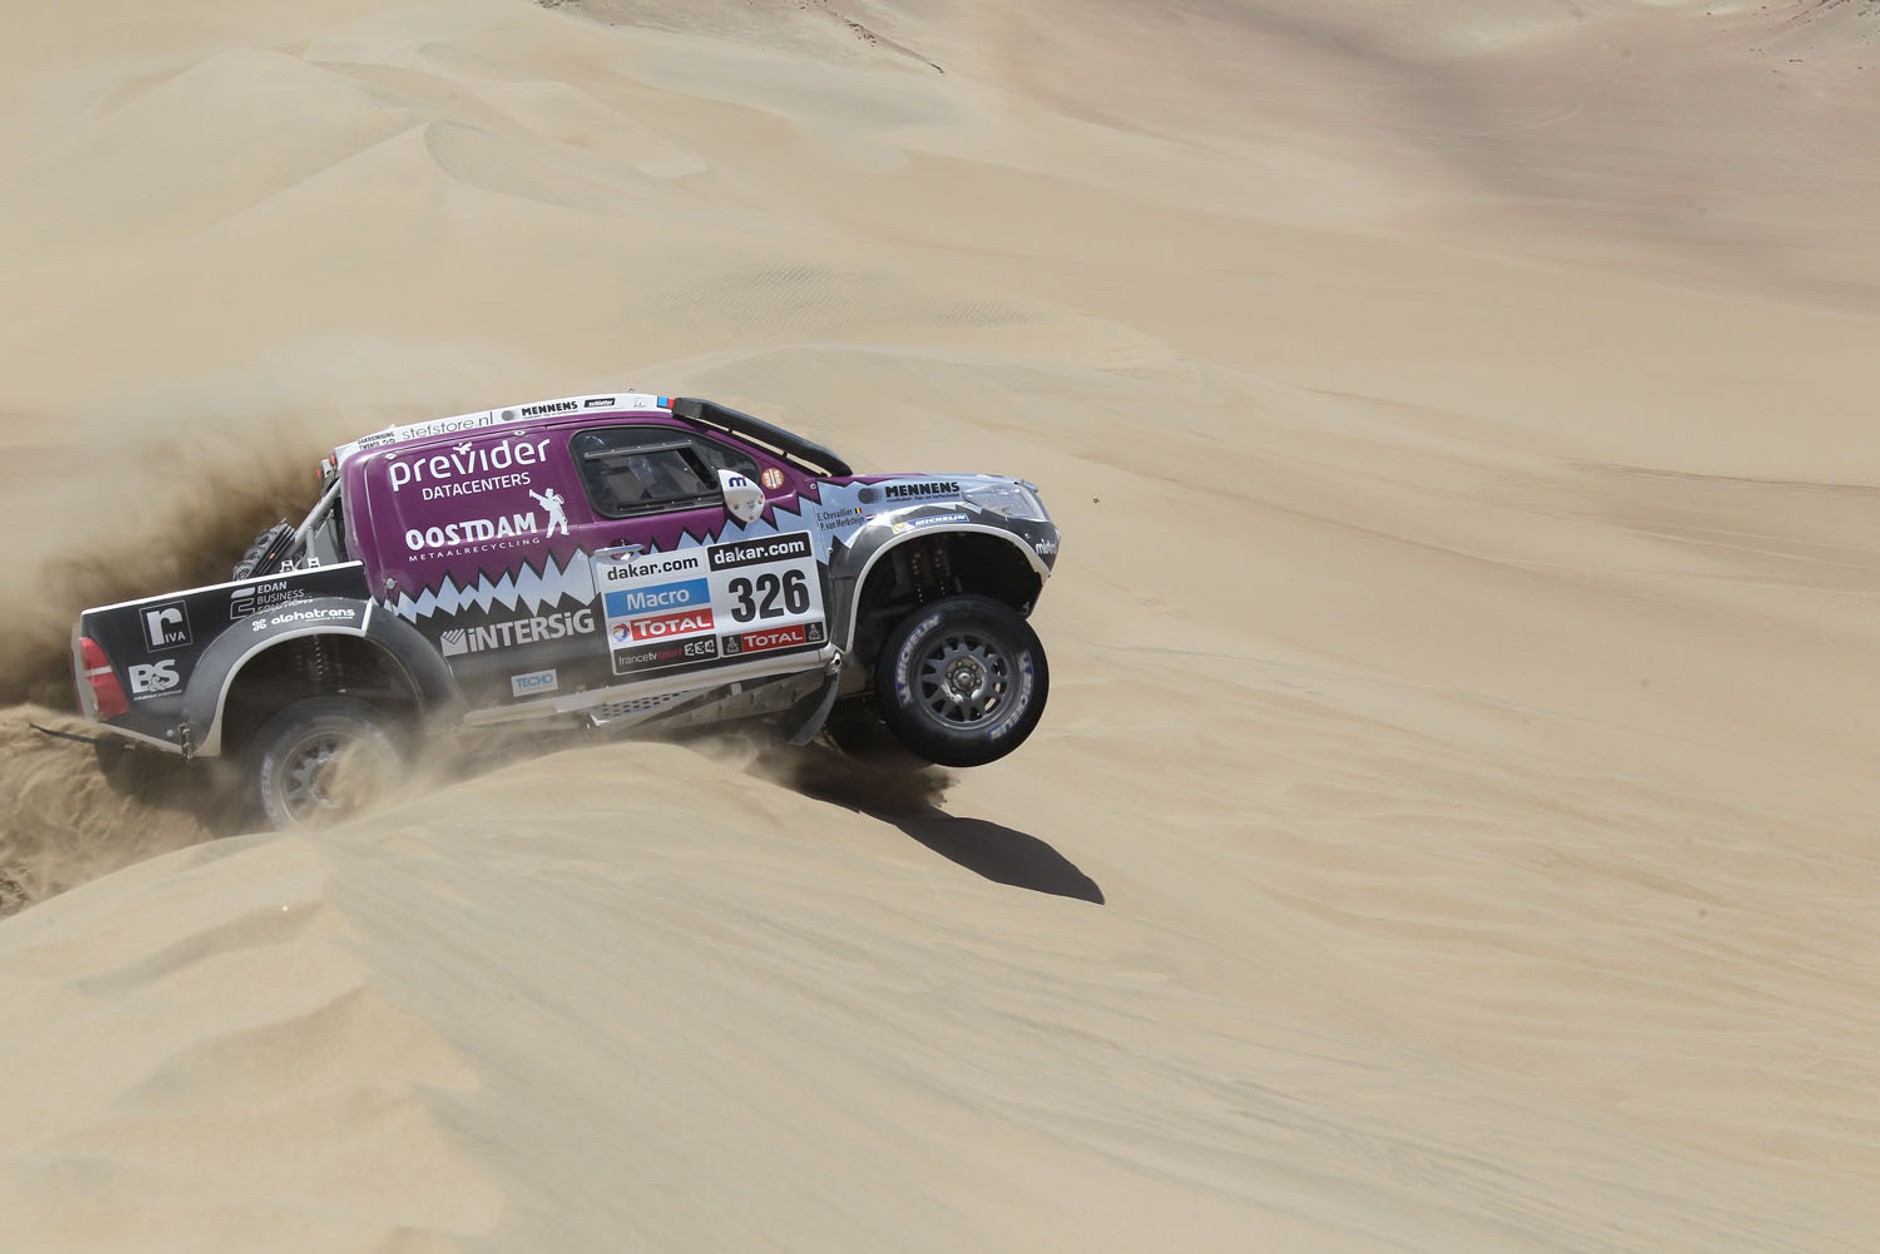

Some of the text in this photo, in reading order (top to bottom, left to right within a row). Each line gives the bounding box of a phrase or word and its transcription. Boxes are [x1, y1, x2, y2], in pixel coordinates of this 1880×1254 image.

[521, 401, 578, 416] MENNENS
[402, 411, 493, 440] stefstore.nl
[389, 438, 550, 492] previder
[422, 472, 531, 500] DATACENTERS
[885, 482, 960, 497] MENNENS
[405, 512, 537, 550] OOSTDAM
[409, 537, 540, 562] METAALRECYCLING
[714, 539, 805, 565] dakar.com
[607, 556, 698, 581] dakar.com
[257, 581, 287, 594] EDAN
[257, 588, 304, 605] BUSINESS
[728, 569, 810, 623] 326
[627, 589, 690, 611] Macro
[271, 609, 355, 625] alphatrans
[633, 615, 711, 637] TOTAL
[743, 631, 803, 648] TOTAL
[515, 673, 554, 688] TECHO
